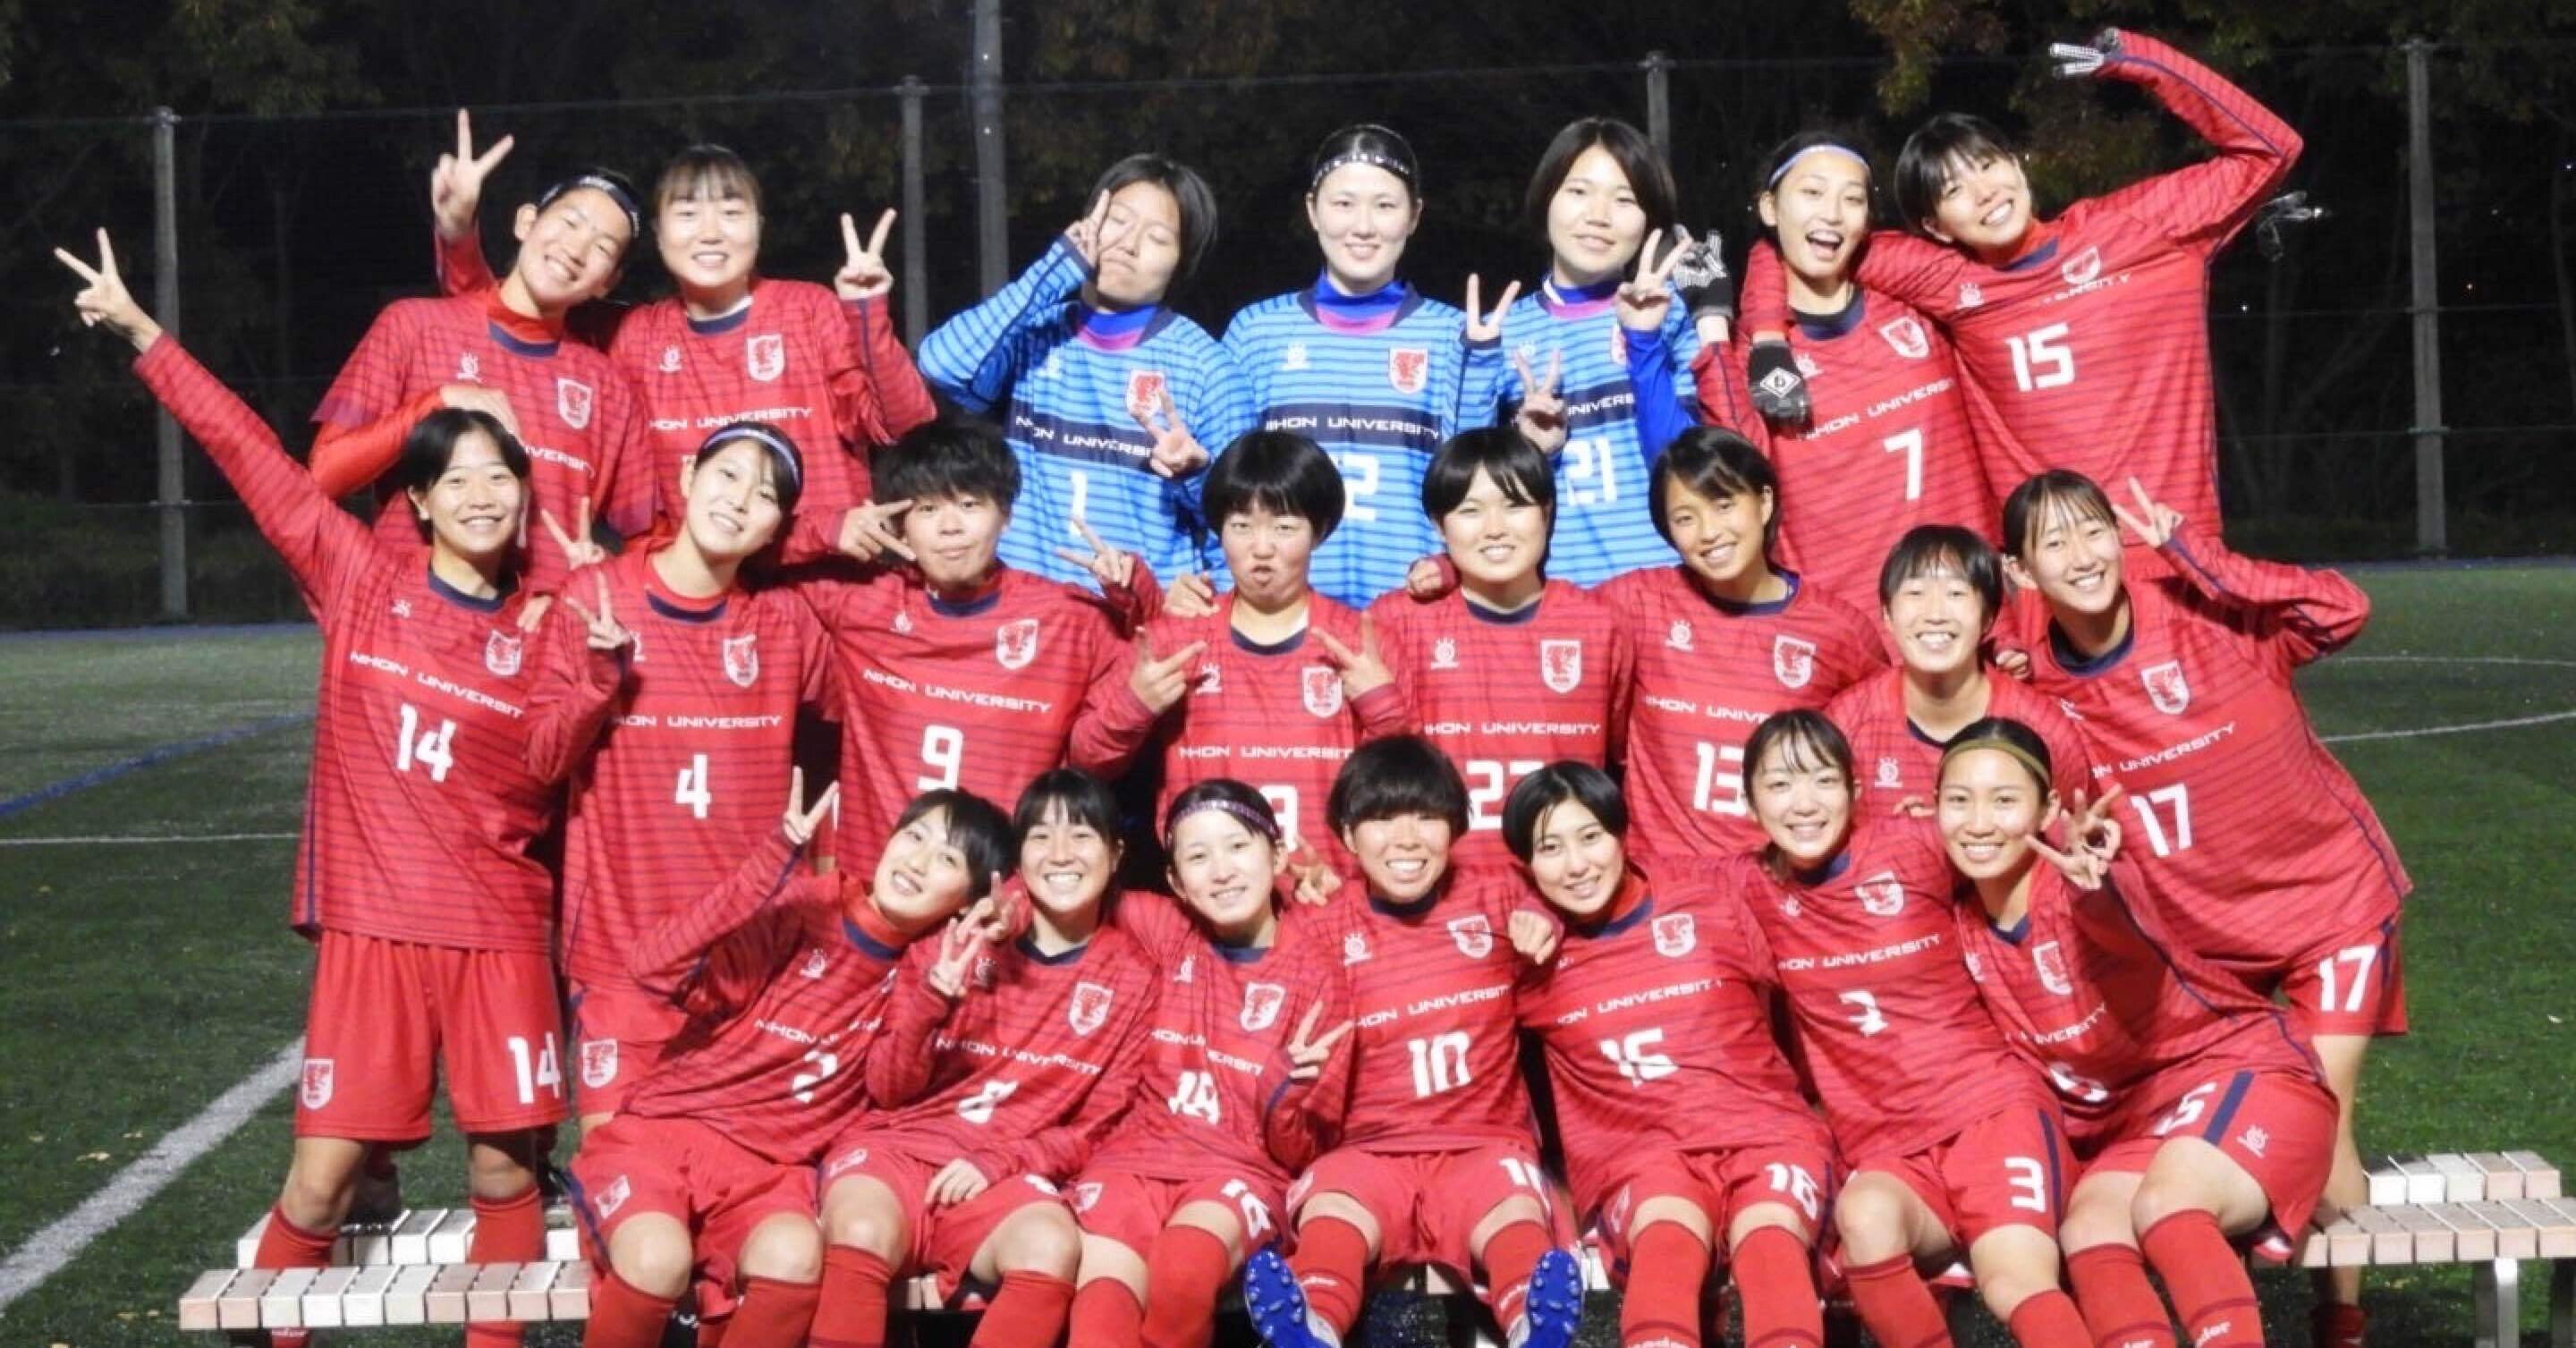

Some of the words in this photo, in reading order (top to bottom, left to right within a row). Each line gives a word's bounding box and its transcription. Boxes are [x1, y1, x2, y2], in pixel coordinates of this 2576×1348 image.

[2004, 323, 2076, 392] 15
[1563, 436, 1618, 505] 21
[1883, 428, 1923, 502] 7
[1069, 471, 1089, 537] 1
[666, 715, 783, 728] UNIVERSITY
[863, 668, 917, 693] NIHON
[925, 684, 1053, 713] UNIVERSITY
[397, 703, 458, 784] 14
[917, 725, 964, 792] 9
[1240, 745, 1354, 759] UNIVERSIT
[1424, 722, 1472, 735] IHON
[1481, 722, 1602, 735] UNIVERSITY
[675, 753, 712, 820] 4
[2131, 782, 2193, 859] 17
[1407, 984, 1512, 1016] UNIVERSIT
[2318, 945, 2377, 1013] 17
[507, 1030, 562, 1105] 14
[1407, 1030, 1473, 1099] 10
[2004, 1157, 2046, 1214] 3
